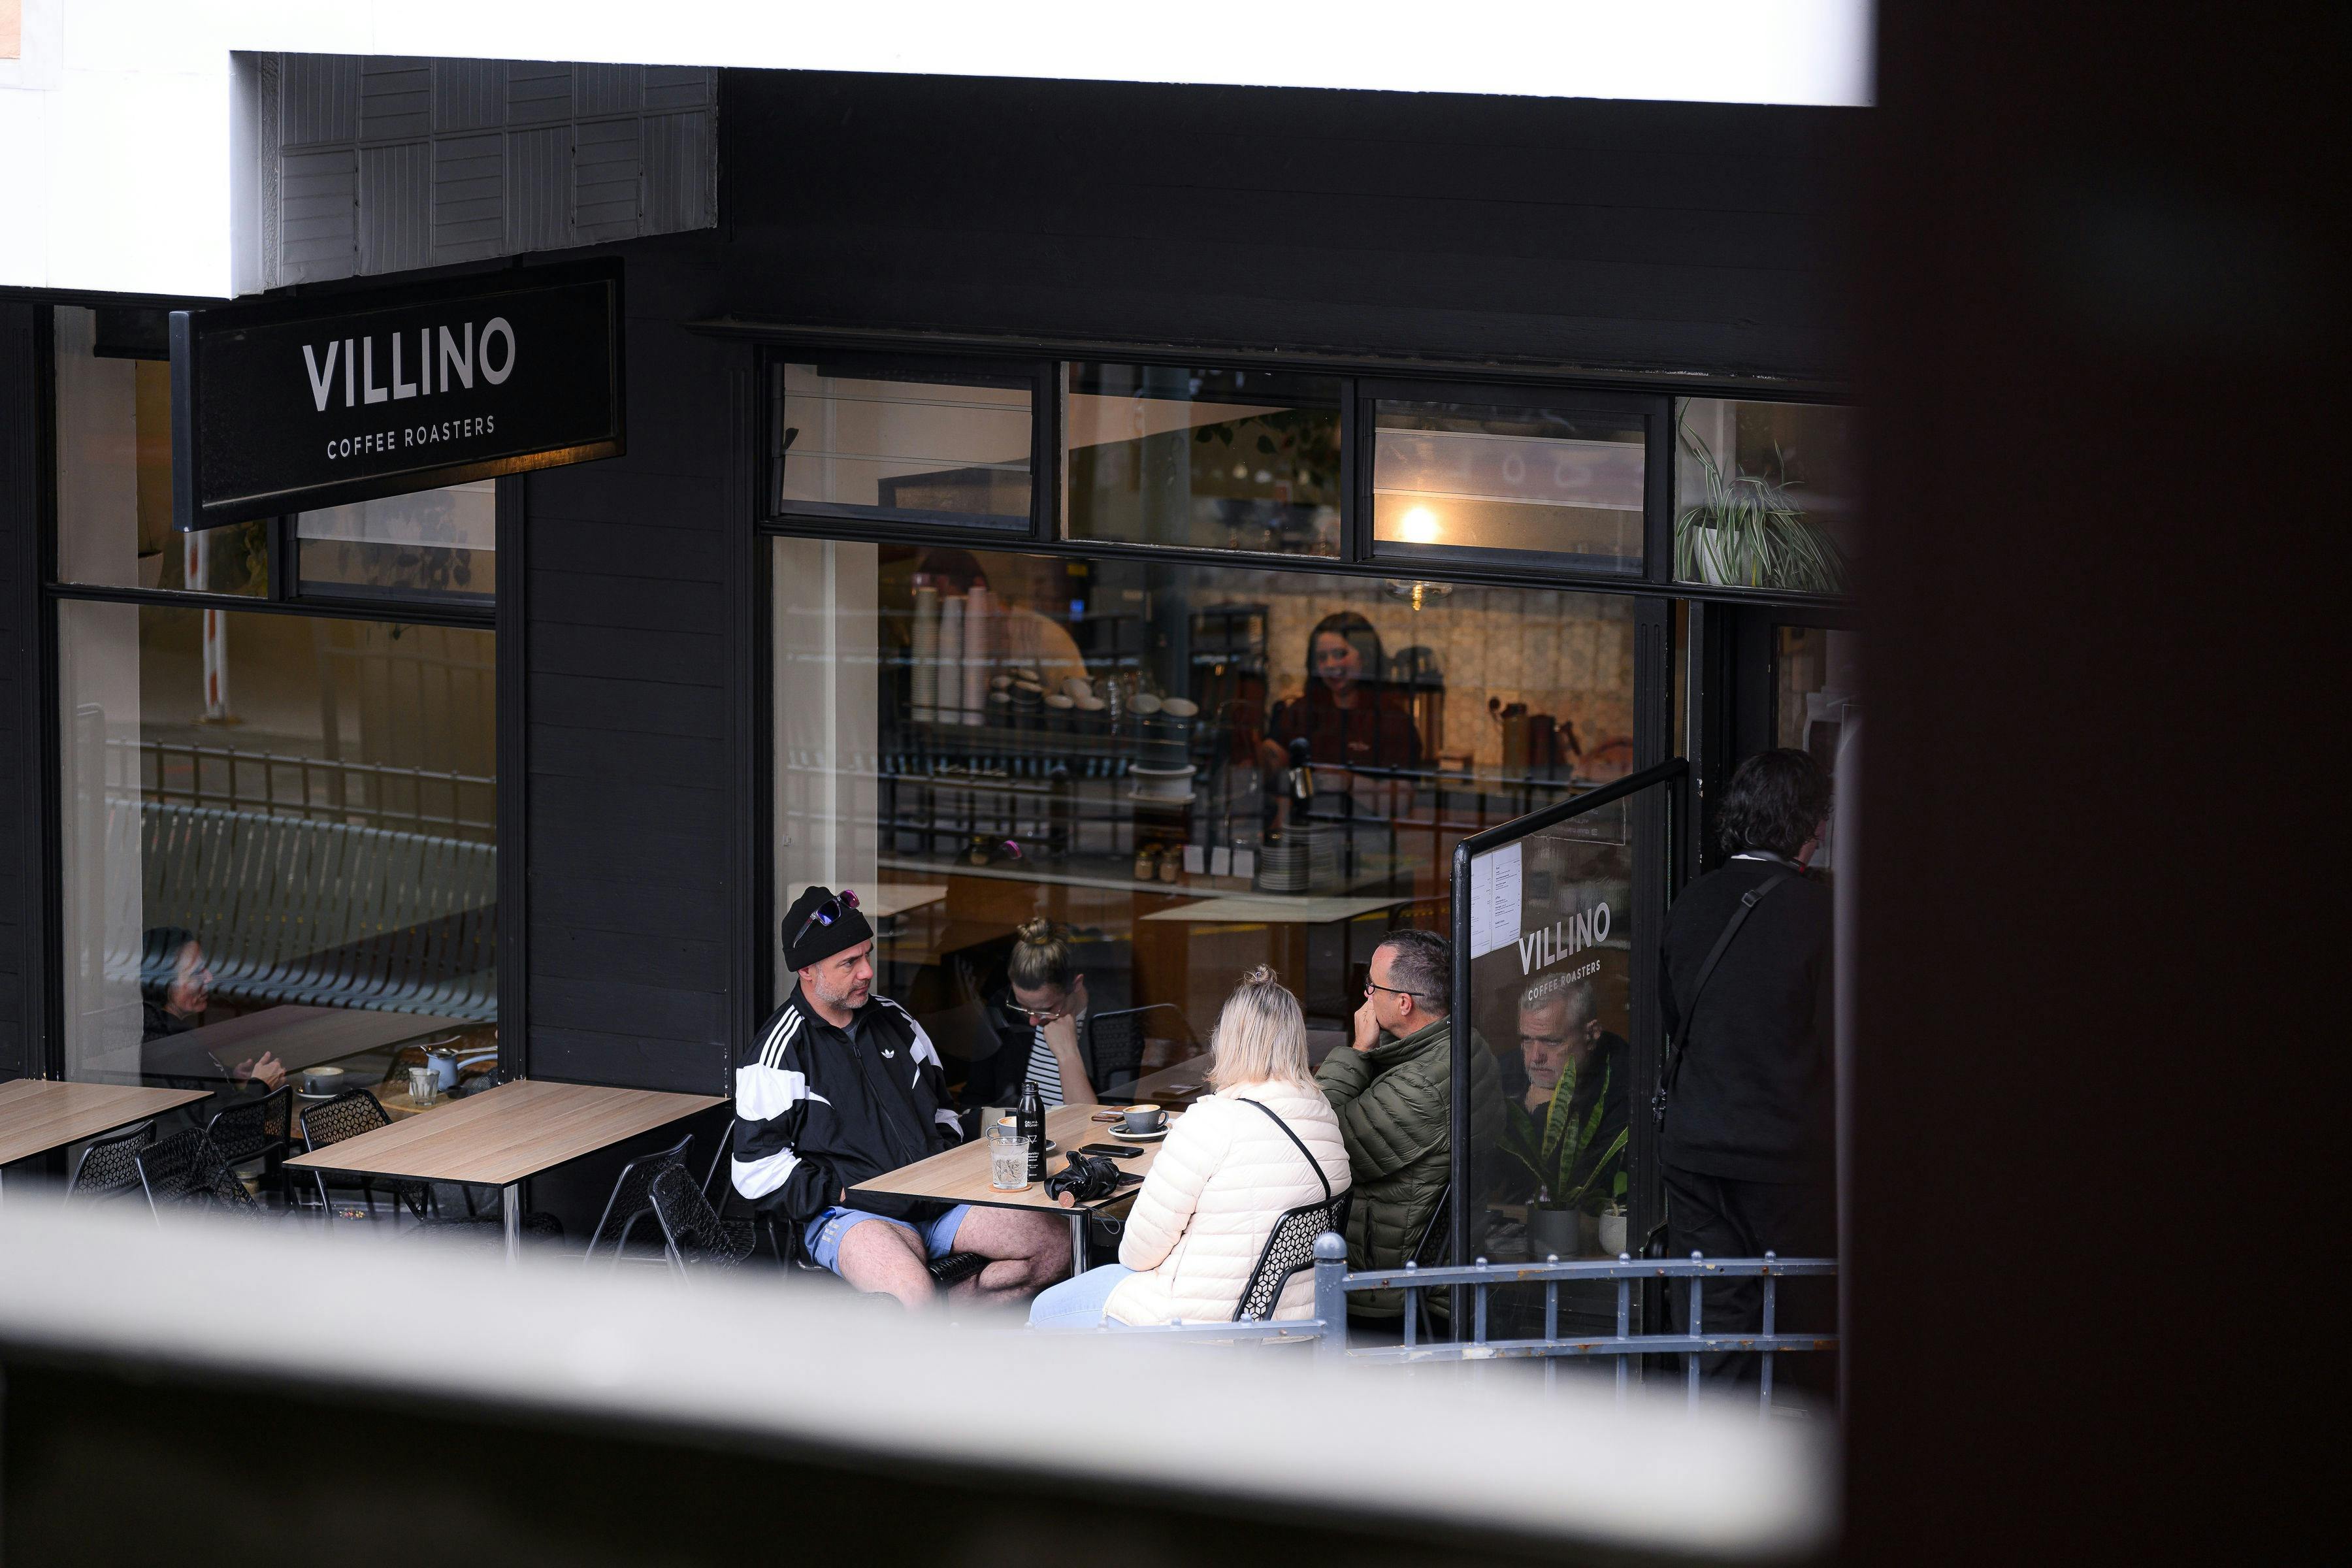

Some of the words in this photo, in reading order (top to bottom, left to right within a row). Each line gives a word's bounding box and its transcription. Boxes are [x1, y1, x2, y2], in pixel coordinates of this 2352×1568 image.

[302, 317, 515, 412] VILLINO
[327, 431, 395, 459] COFFEE
[405, 416, 495, 447] ROASTERS
[1519, 902, 1610, 975] VILLINO
[1528, 979, 1558, 1002] COFFEE
[1561, 959, 1601, 987] ROASTERS
